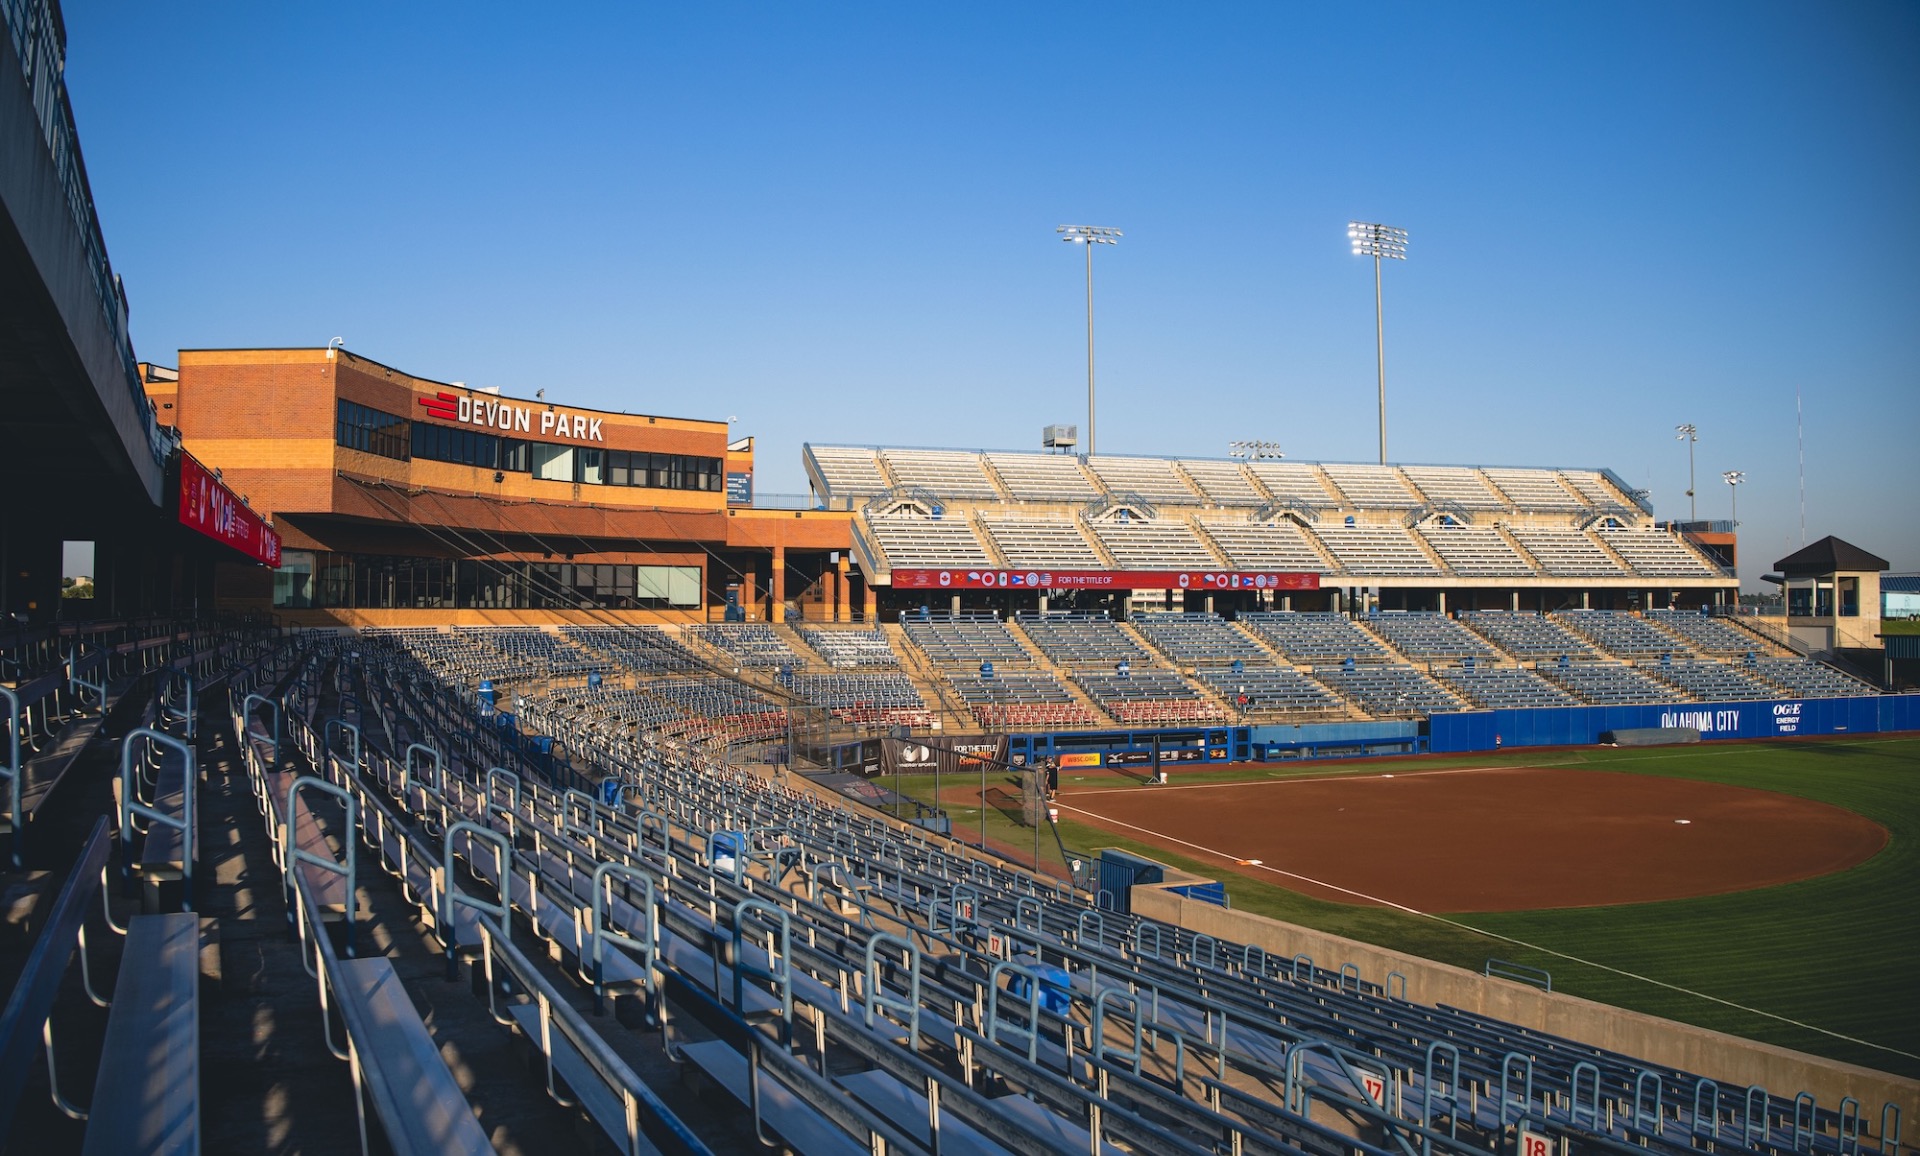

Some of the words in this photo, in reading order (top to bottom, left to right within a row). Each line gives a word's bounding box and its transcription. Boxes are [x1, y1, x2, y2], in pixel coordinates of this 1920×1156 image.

[458, 396, 530, 432] DEVON
[540, 411, 603, 442] PARK
[1058, 576, 1072, 584] FOR
[1072, 576, 1086, 584] THE
[1086, 576, 1103, 584] TITLE
[1103, 576, 1113, 584] OF
[1716, 710, 1740, 732] CITY
[1776, 717, 1800, 725] ENERGY
[954, 745, 968, 753] FOR
[981, 744, 997, 752] TITLE
[991, 937, 1000, 952] 17
[1366, 1079, 1382, 1100] 17
[1525, 1136, 1546, 1156] 18
